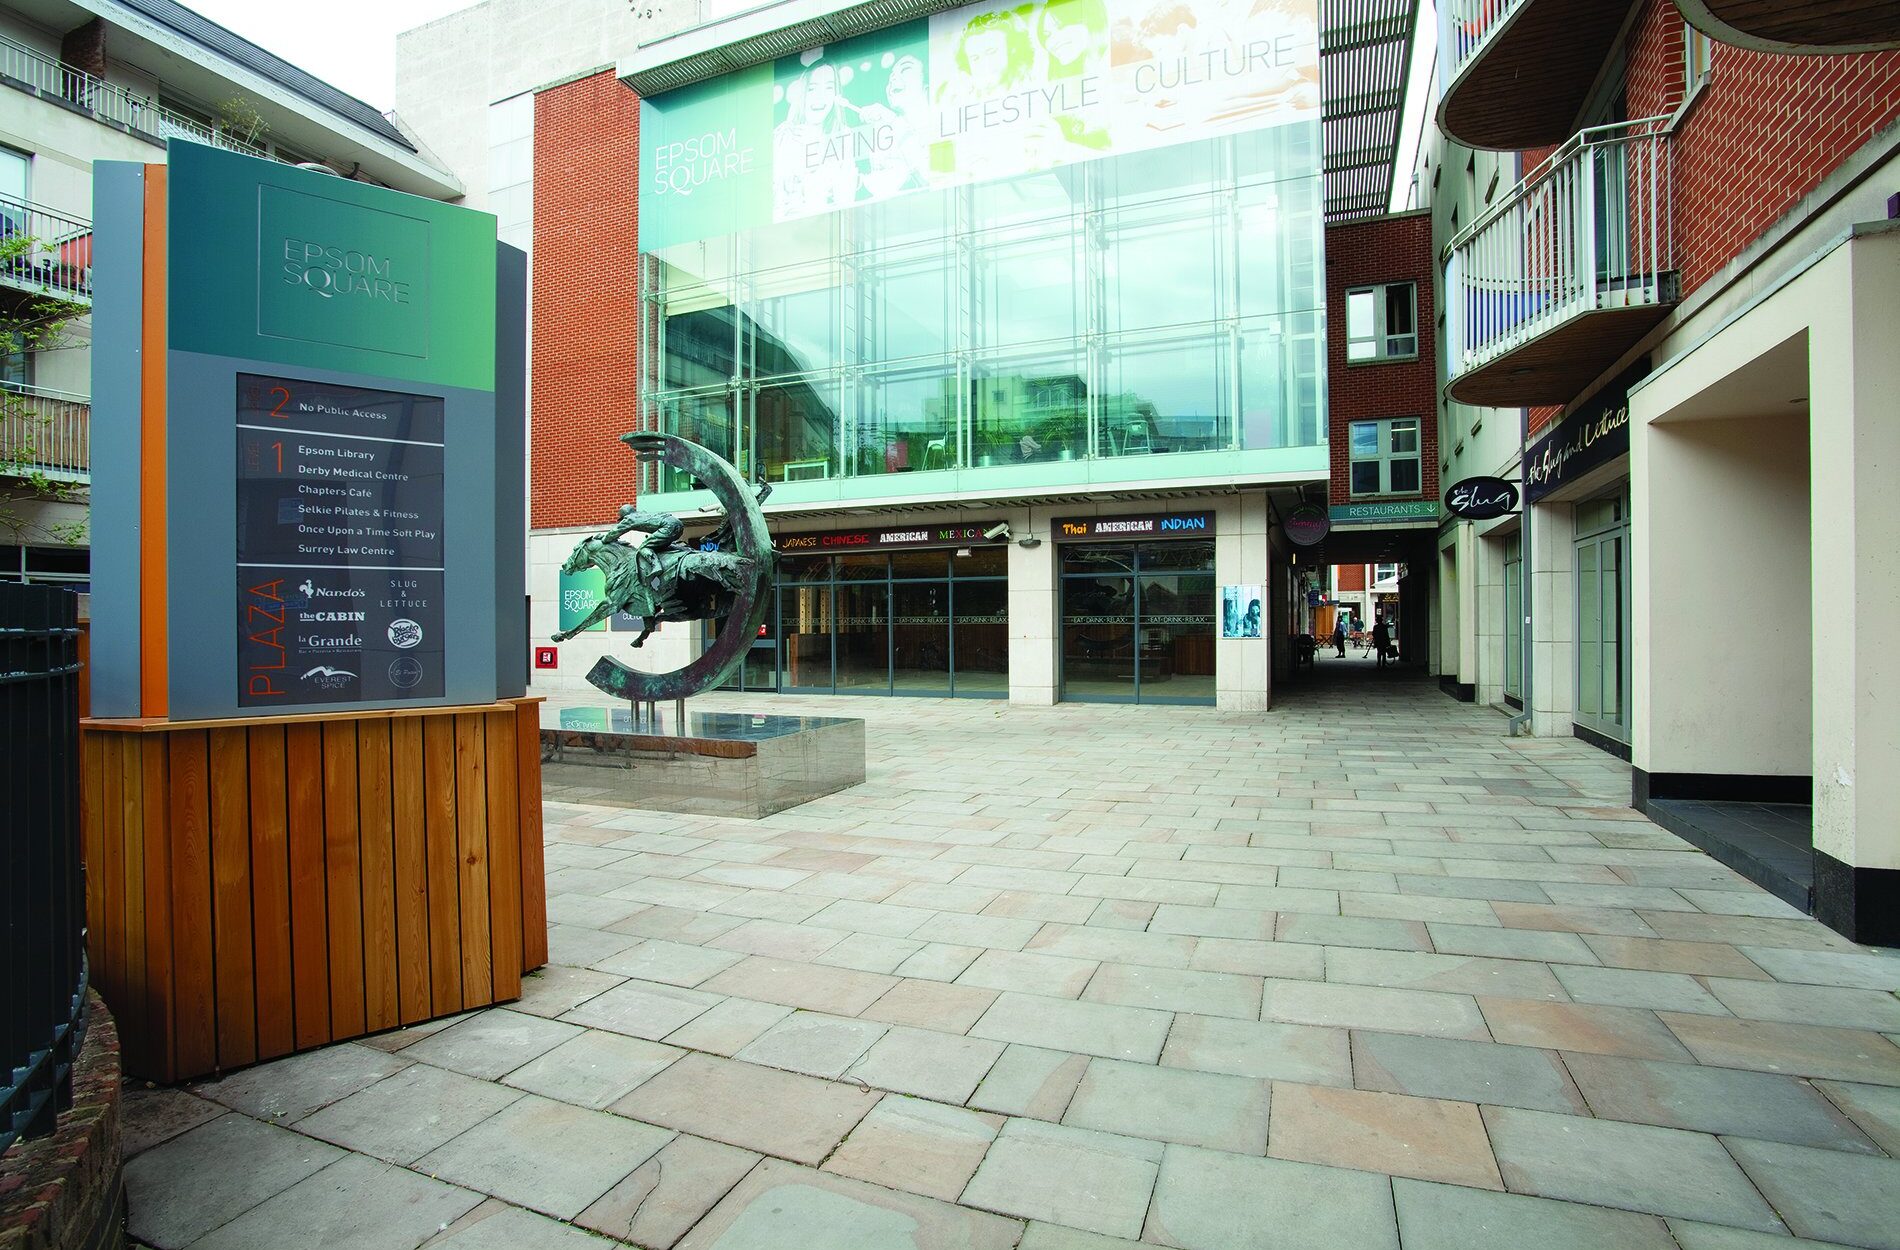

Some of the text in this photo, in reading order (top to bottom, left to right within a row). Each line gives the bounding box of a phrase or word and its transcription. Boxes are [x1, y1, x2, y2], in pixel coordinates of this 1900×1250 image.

[805, 34, 1295, 168] EATING LIFESTYLE CULTURE
[656, 128, 736, 171] EPSOM
[655, 148, 754, 196] SQUARE
[284, 237, 389, 278] EPSOM
[283, 262, 410, 304] SQUARE
[269, 387, 290, 419] 2
[299, 403, 387, 420] No Public Access
[1585, 405, 1630, 448] Lettuce
[272, 441, 284, 474] 1
[298, 445, 375, 462] Epsom Library
[298, 465, 409, 482] Derby Medical Centre
[298, 485, 372, 498] Chapters Café
[1451, 486, 1511, 512] Slug
[298, 504, 419, 520] Selkie Pilates & Fitness
[1349, 505, 1421, 516] RESTAURANTS
[298, 525, 325, 534] Once
[327, 526, 355, 538] Upon
[365, 527, 390, 537] Time
[392, 529, 413, 538] Soft
[415, 530, 436, 541] Play
[1063, 517, 1205, 535] Thai AMERICAN INDIAN
[782, 537, 817, 548] JAPANESE
[822, 534, 870, 546] CHINESE
[880, 531, 929, 543] AMERICAN
[298, 544, 395, 556] Surrey Law Centre
[316, 587, 366, 598] Nando's
[390, 580, 418, 588] SLUG
[401, 590, 407, 598] &
[564, 589, 594, 600] EPSOM
[380, 600, 427, 608] LETTUCE
[247, 578, 286, 696] PLAZA
[309, 634, 362, 647] Grande
